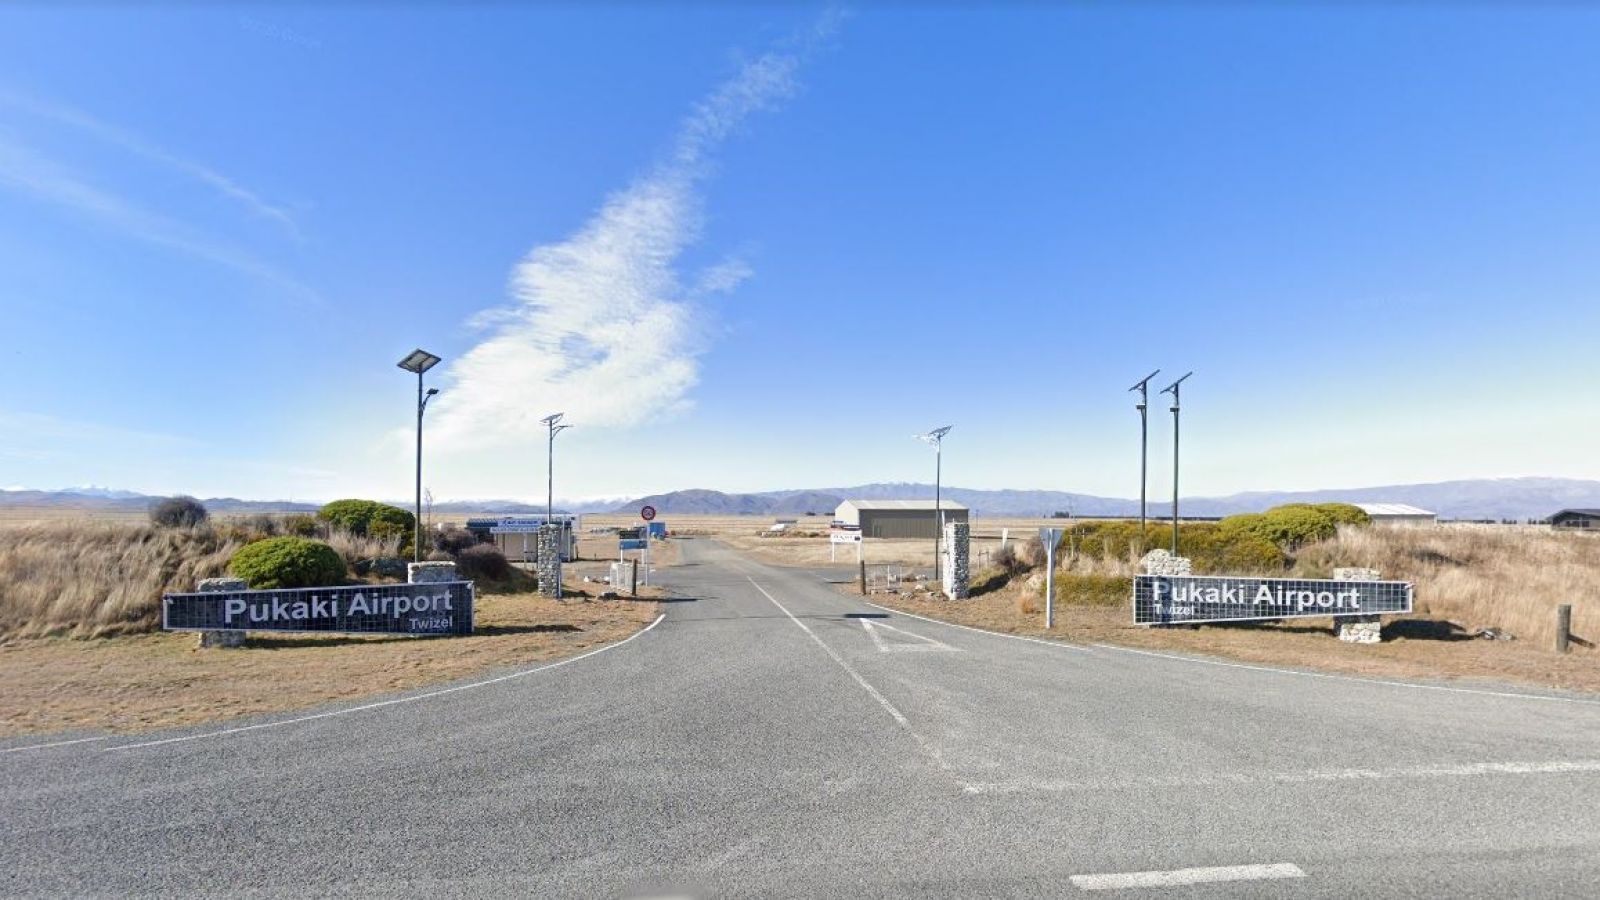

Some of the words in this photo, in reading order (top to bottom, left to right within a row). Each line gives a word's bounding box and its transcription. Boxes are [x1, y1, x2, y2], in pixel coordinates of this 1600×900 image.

[224, 595, 338, 623] Pukaki
[349, 590, 453, 618] Airport
[1153, 580, 1244, 605] Pukaki
[1253, 584, 1360, 611] Airport
[409, 616, 453, 630] Twizel
